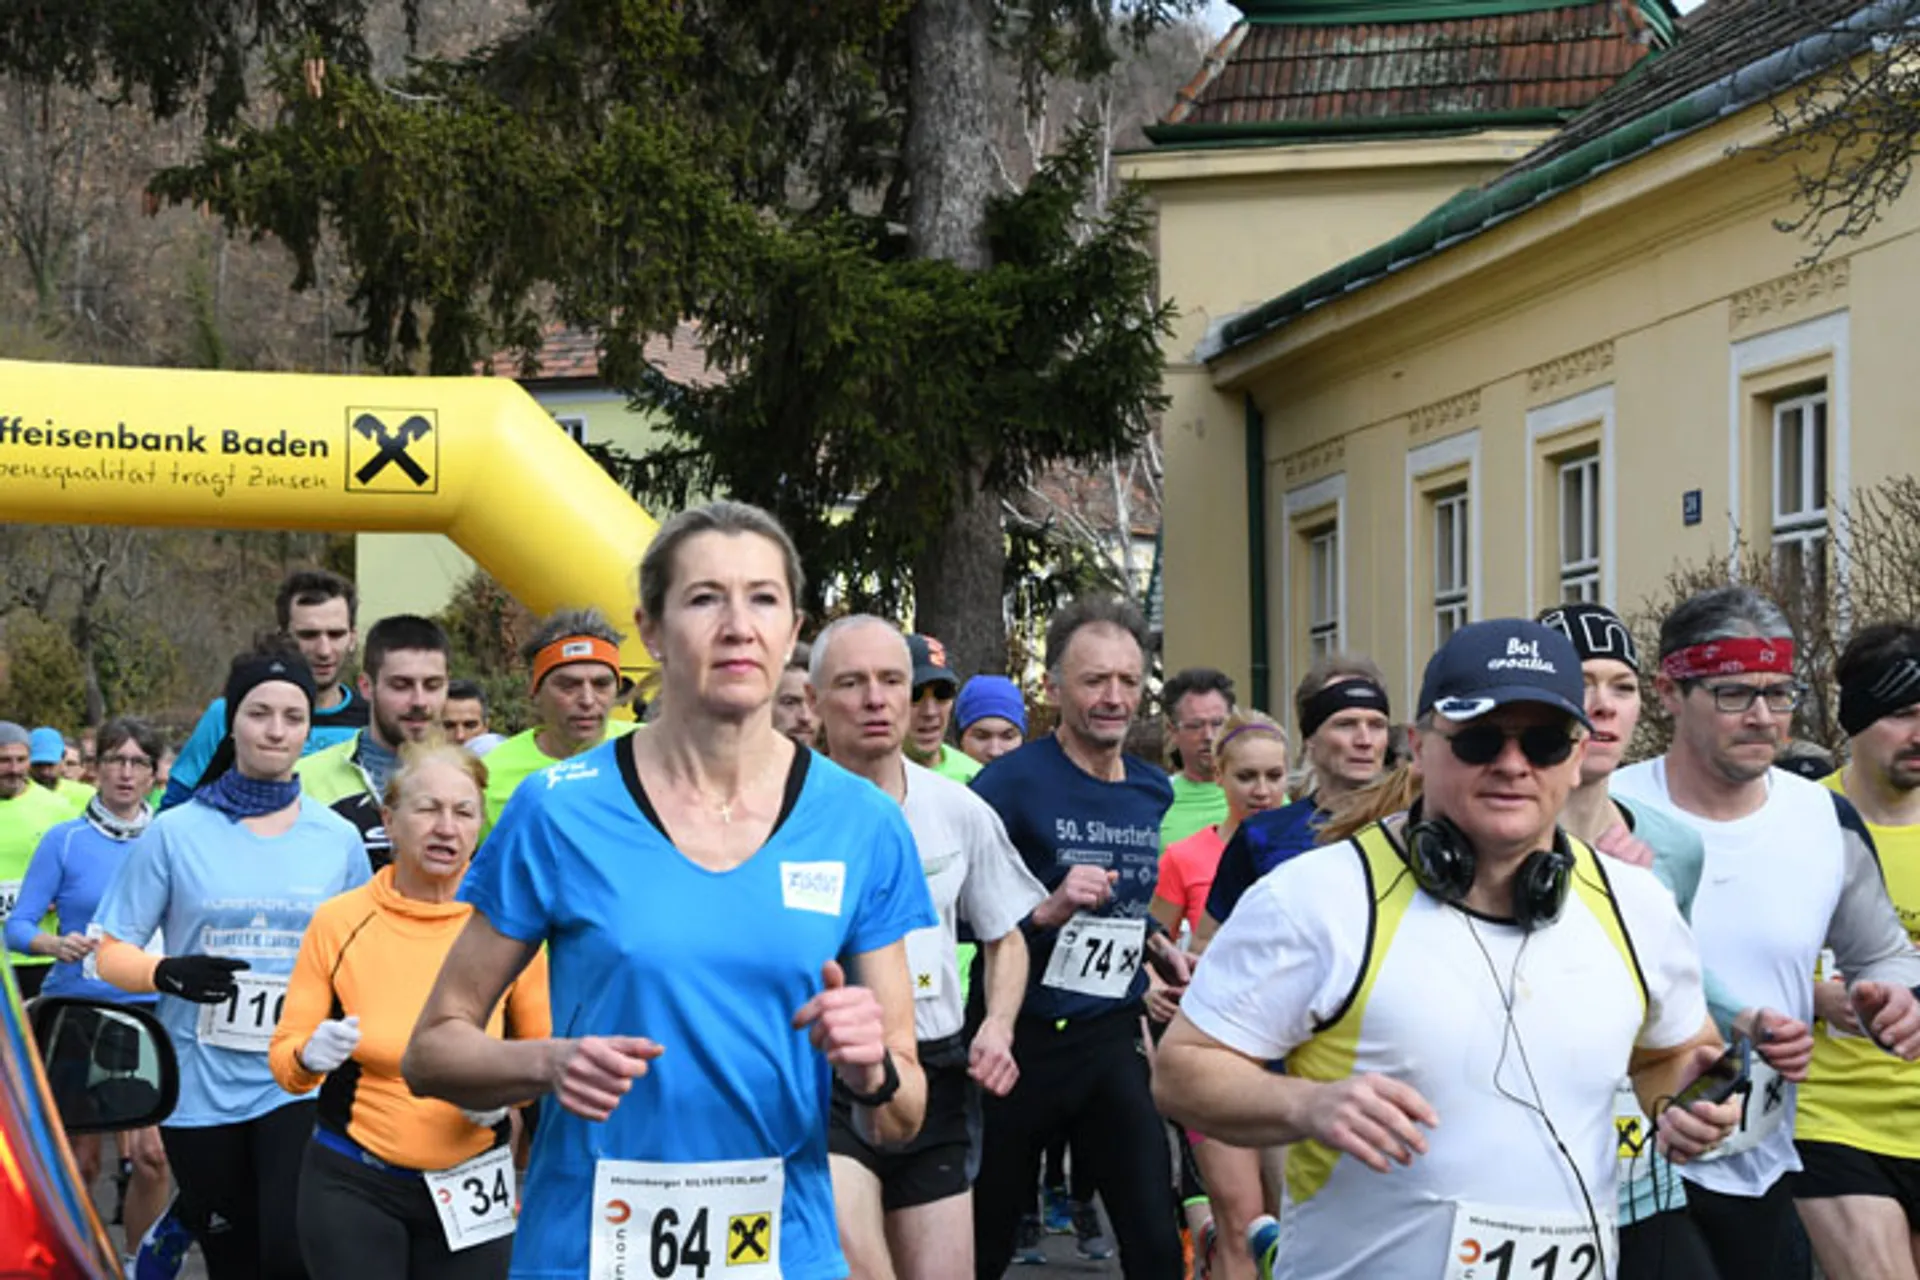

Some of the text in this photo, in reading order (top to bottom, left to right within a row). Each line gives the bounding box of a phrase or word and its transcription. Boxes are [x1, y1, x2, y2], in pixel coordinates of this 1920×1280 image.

[221, 429, 329, 458] Baden
[1507, 637, 1539, 657] Bol
[1056, 818, 1083, 841] 50.
[1080, 937, 1115, 980] 74
[462, 1167, 509, 1217] 34
[615, 1228, 628, 1280] nion
[651, 1206, 711, 1279] 64
[1484, 1239, 1598, 1280] 112
